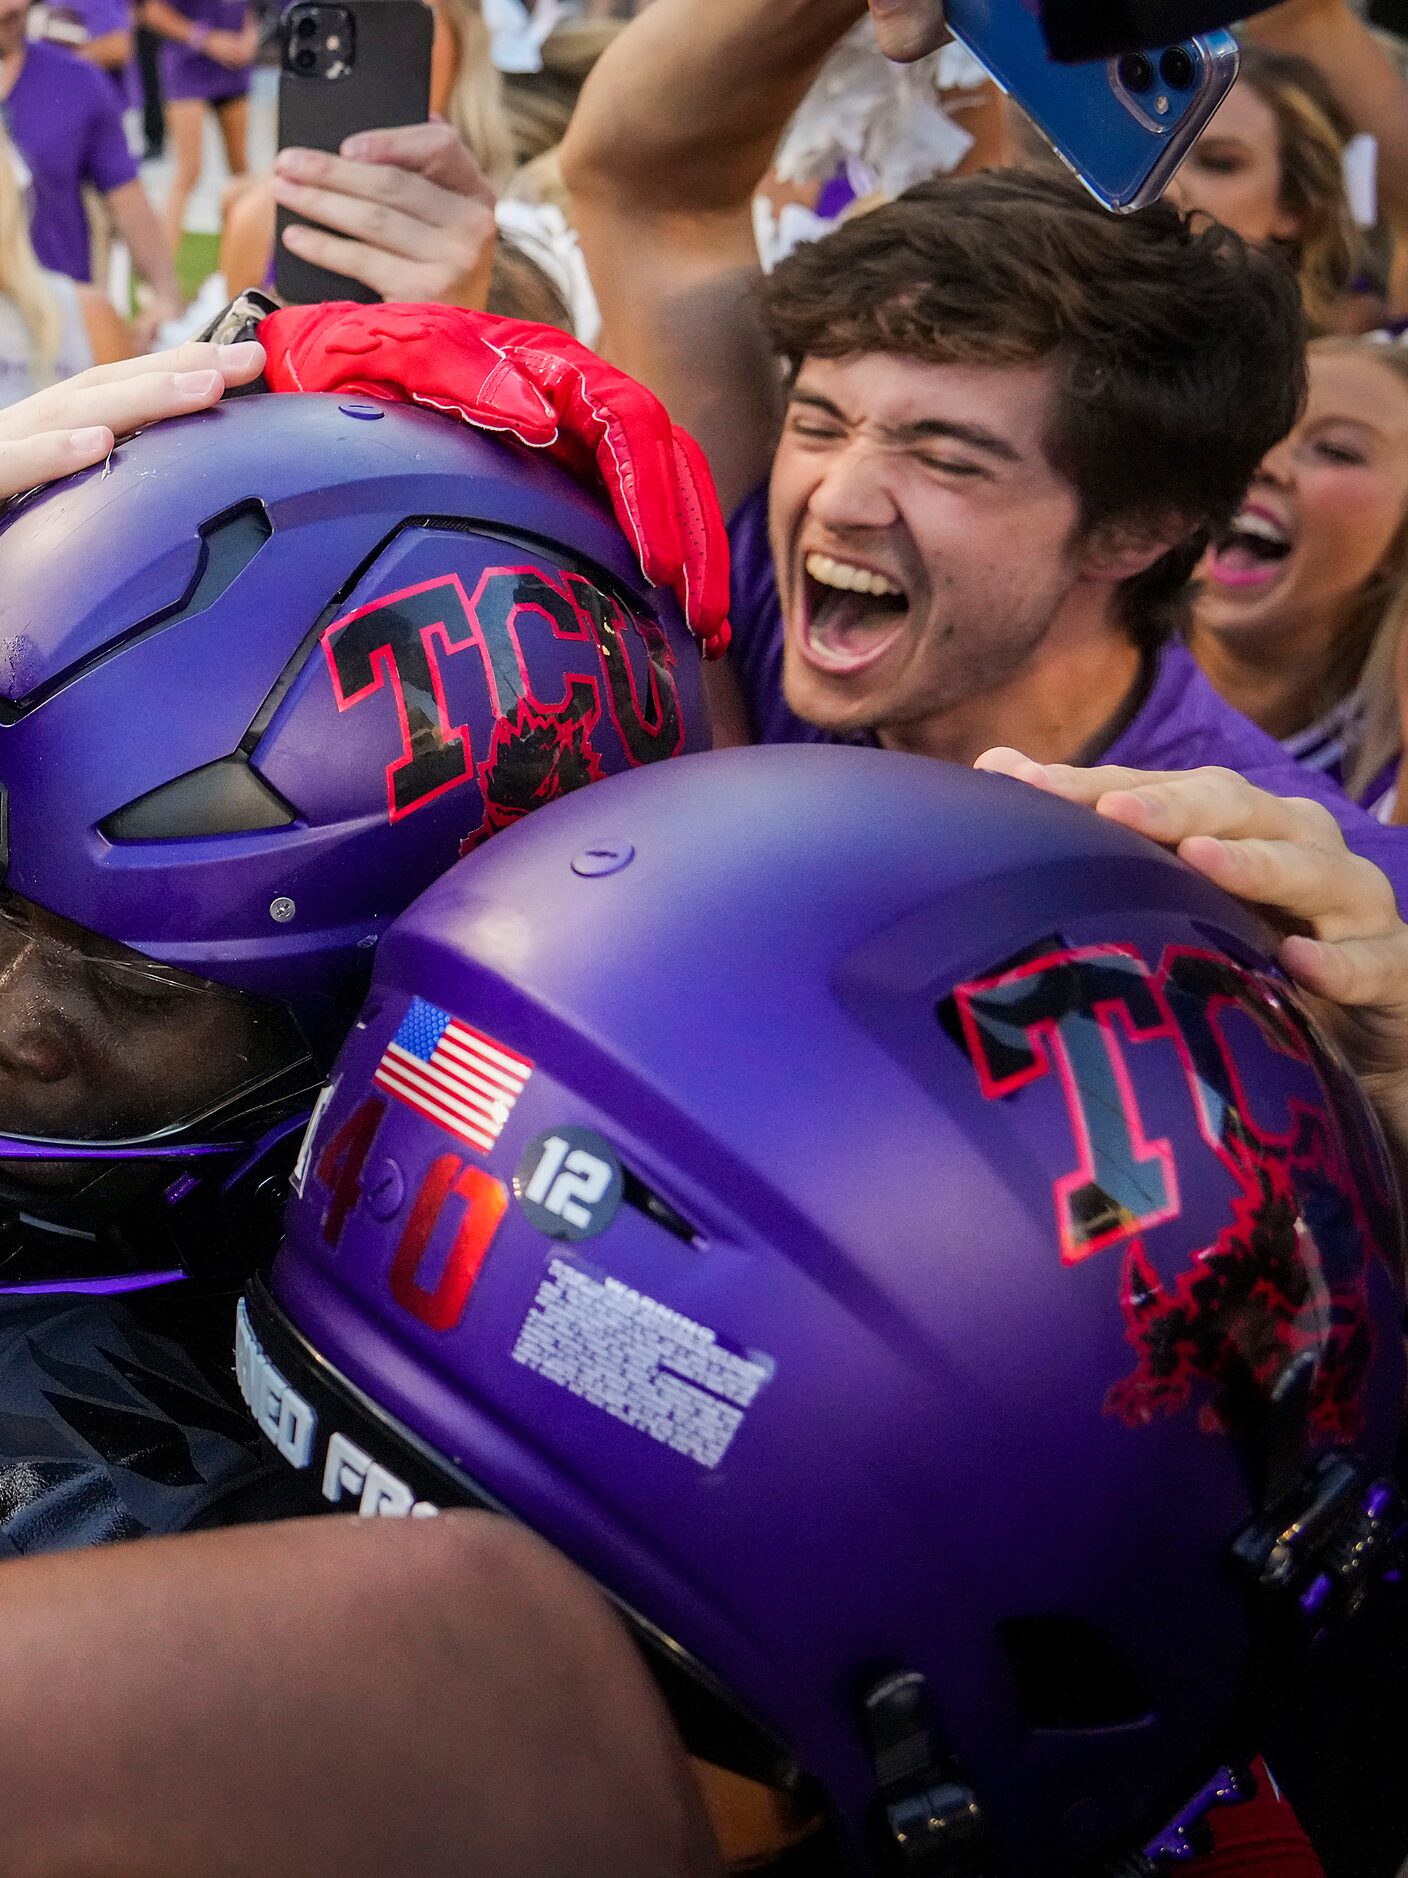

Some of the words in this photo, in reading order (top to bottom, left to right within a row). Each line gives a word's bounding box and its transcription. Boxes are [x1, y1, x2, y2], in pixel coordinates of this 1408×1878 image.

[310, 575, 684, 826] TCU
[314, 1097, 510, 1332] 40
[525, 1135, 613, 1230] 12
